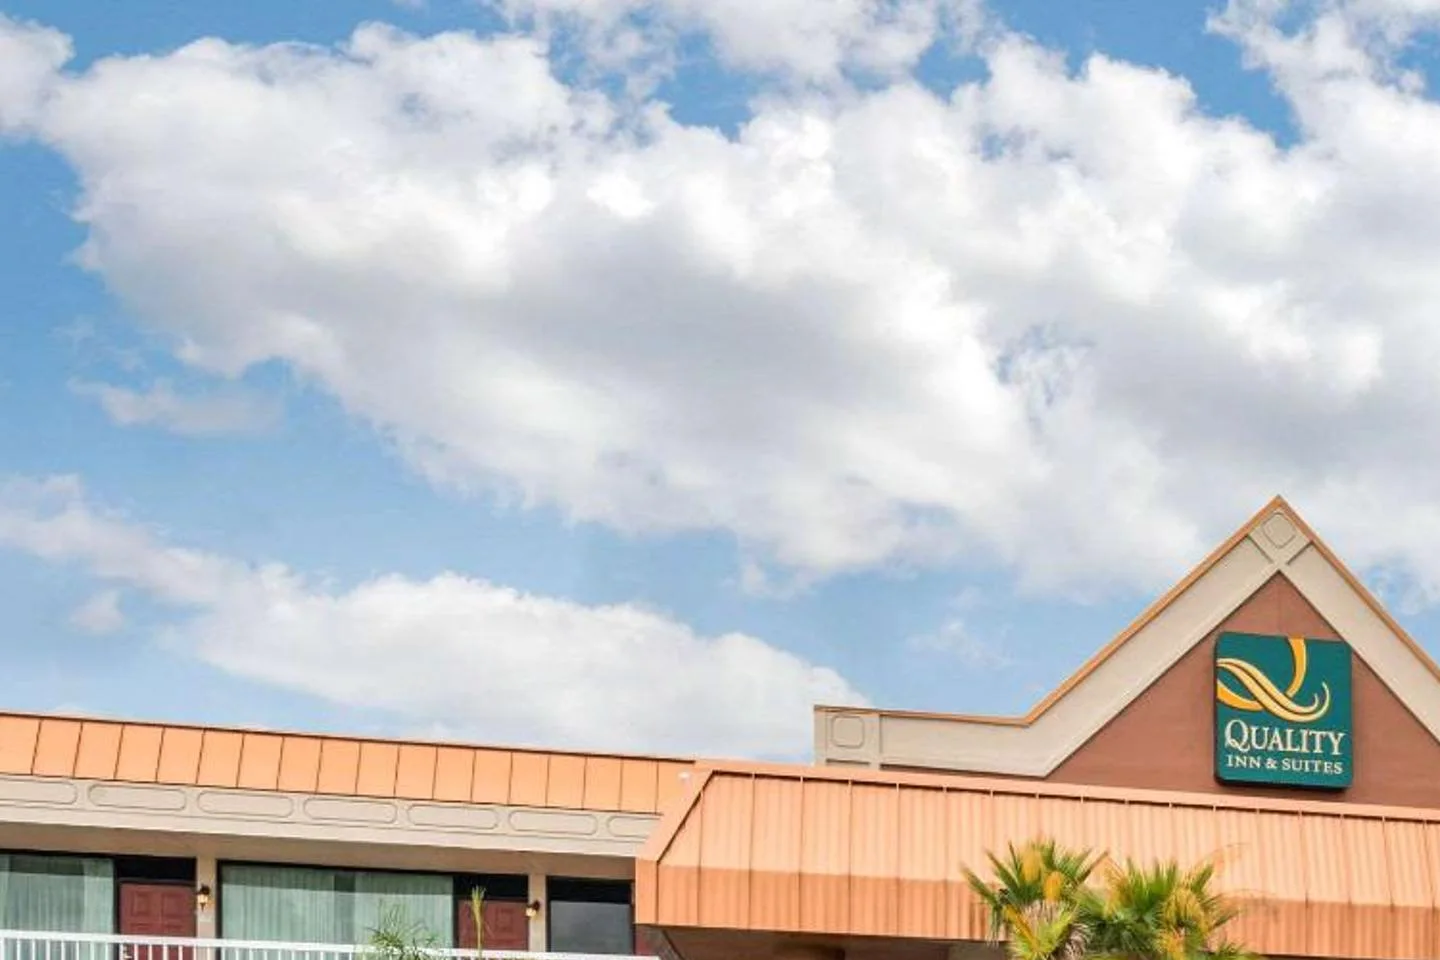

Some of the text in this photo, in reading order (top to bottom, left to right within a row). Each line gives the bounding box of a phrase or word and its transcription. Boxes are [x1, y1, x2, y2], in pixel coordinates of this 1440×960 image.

[1224, 718, 1346, 755] QUALITY
[1226, 754, 1343, 774] INN & SUITES
